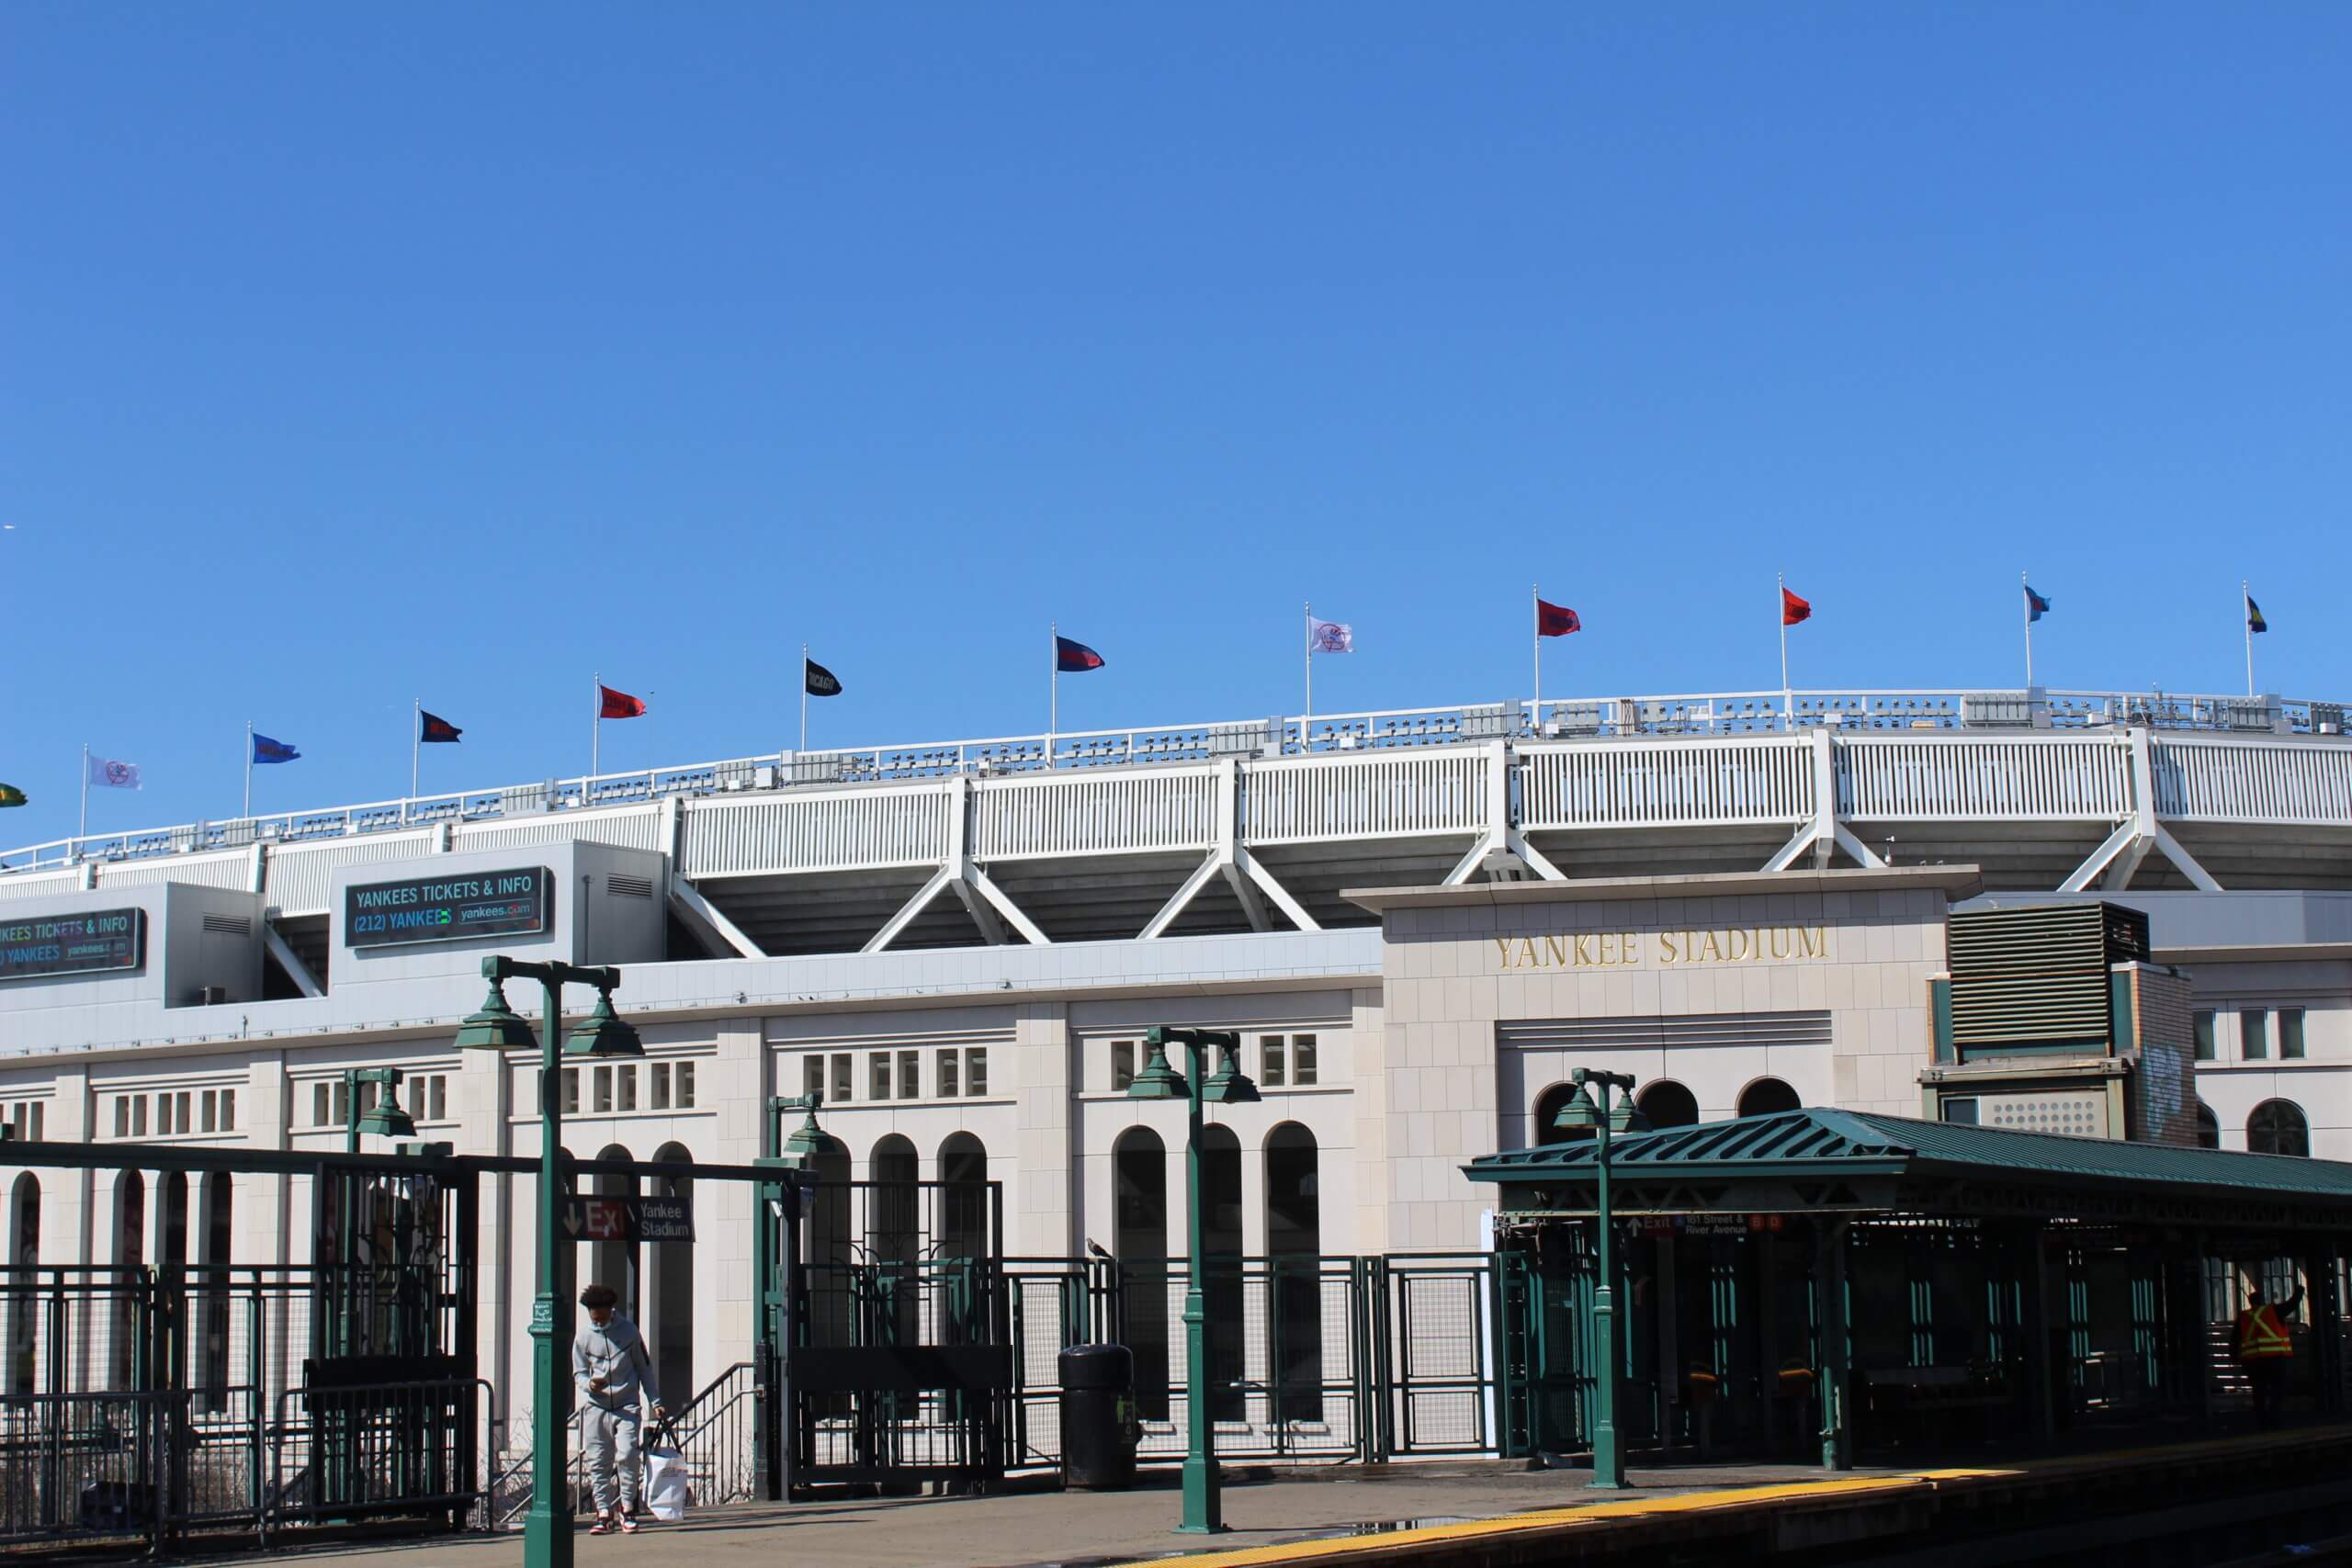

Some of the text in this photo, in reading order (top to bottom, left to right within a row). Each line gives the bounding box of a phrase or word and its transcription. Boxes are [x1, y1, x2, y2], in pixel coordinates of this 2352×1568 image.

[808, 671, 834, 691] CAGO
[356, 875, 532, 908] YANKEES TICKETS & INFO
[355, 903, 530, 933] (212) YANKEES yankees.com
[0, 916, 128, 942] KEES TICKETS & INFO
[7, 944, 60, 964] YANKEES
[67, 942, 126, 957] yankees.cm
[1493, 925, 1829, 970] YANKEE STADIUM
[585, 1201, 625, 1233] Exi
[640, 1202, 682, 1219] Yankee
[1687, 1214, 1701, 1224] 161
[1703, 1213, 1734, 1224] Street
[641, 1221, 689, 1235] Stadium
[1645, 1215, 1670, 1228] Exit
[1686, 1224, 1747, 1235] River Avenue
